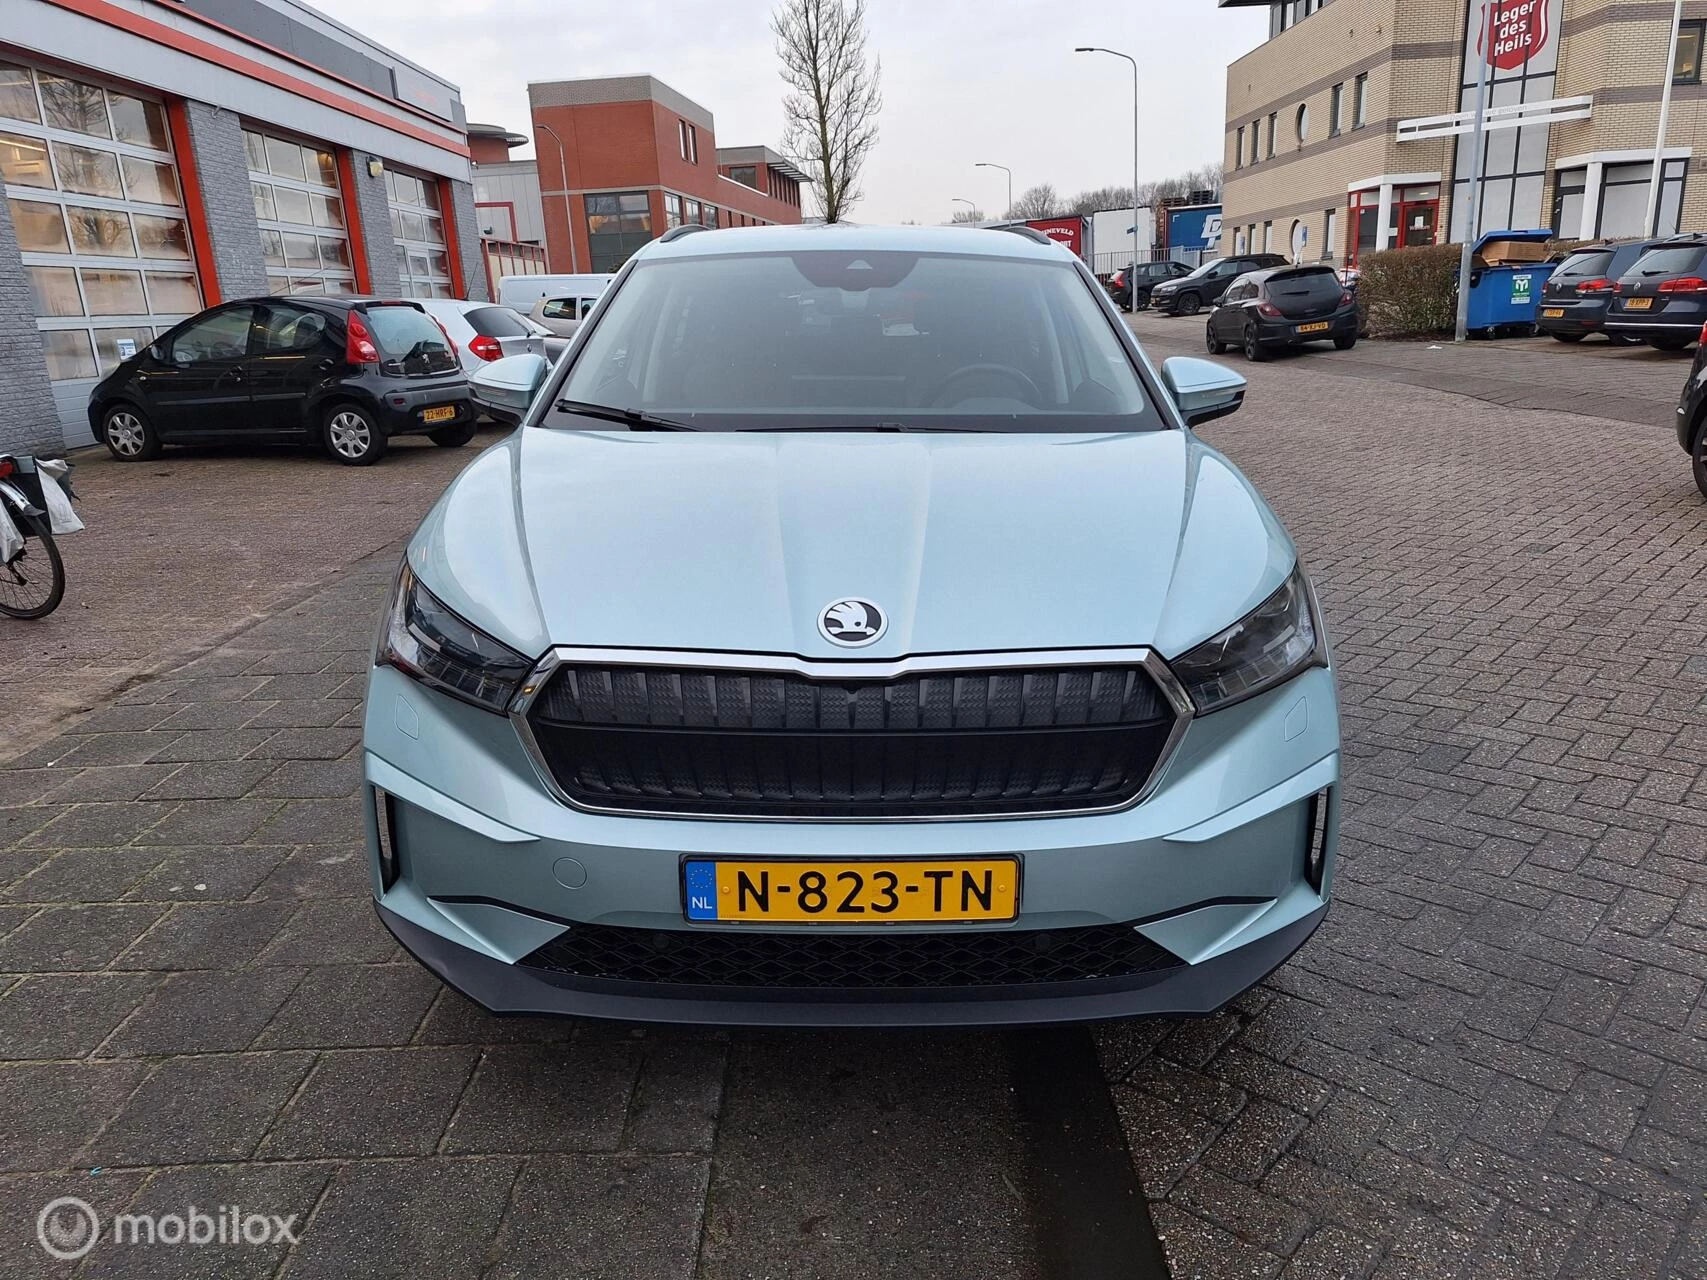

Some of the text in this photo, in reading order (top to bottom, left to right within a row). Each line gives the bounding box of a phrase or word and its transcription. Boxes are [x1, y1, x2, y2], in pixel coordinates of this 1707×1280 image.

[1494, 0, 1536, 26] Leger
[1500, 20, 1527, 39] des
[1494, 33, 1532, 57] Heils
[692, 870, 992, 913] NL N-823-TN
